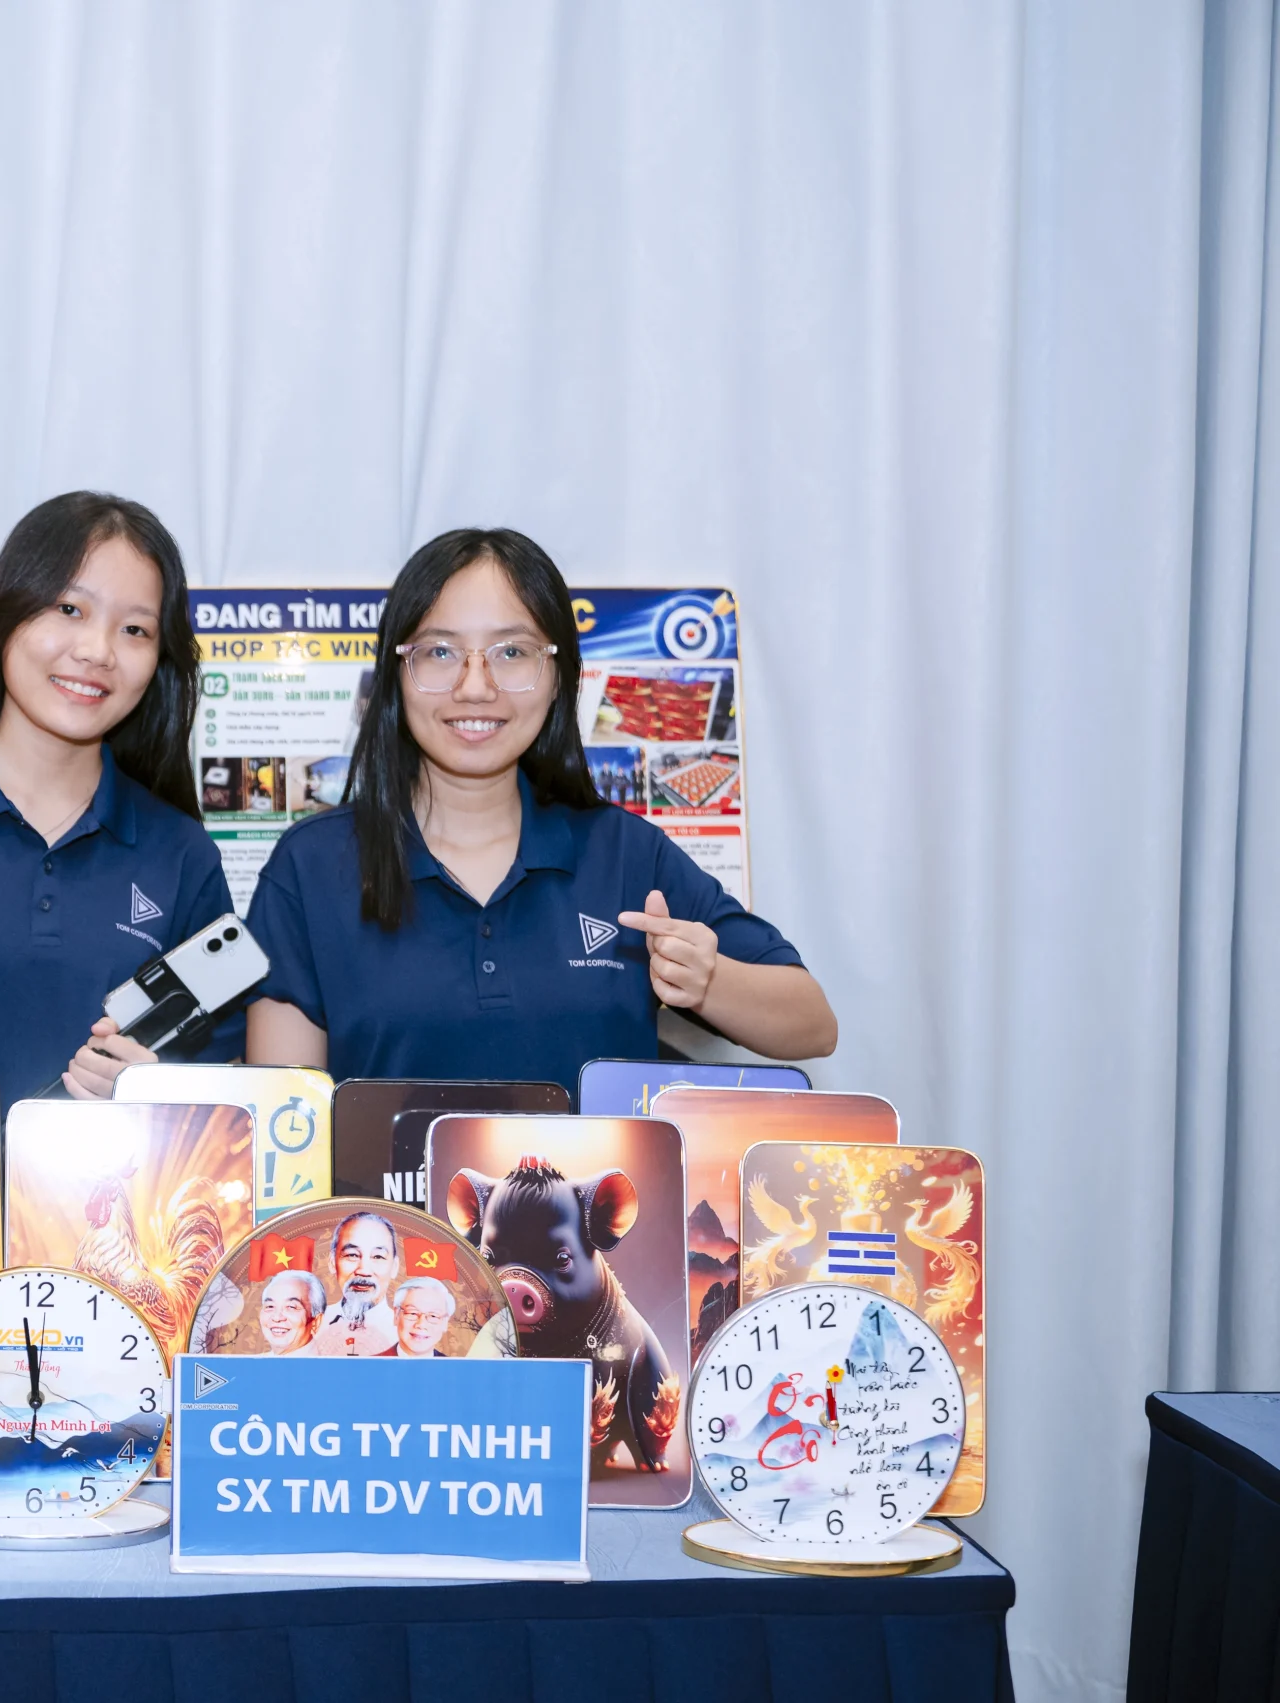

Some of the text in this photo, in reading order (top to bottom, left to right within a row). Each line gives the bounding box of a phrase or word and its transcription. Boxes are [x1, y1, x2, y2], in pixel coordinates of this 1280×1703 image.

[195, 602, 282, 629] ĐANG
[287, 597, 342, 629] TÌM
[211, 639, 264, 661] HỢP
[204, 678, 227, 695] 02
[115, 922, 130, 933] TOM
[19, 1281, 55, 1308] 12
[86, 1294, 97, 1320] 1
[800, 1302, 836, 1329] 12
[869, 1309, 881, 1336] 1
[120, 1334, 138, 1360] 2
[749, 1324, 779, 1351] 11
[908, 1346, 926, 1373] 2
[717, 1364, 753, 1391] 10
[139, 1387, 157, 1413] 3
[932, 1397, 950, 1424] 3
[51, 1419, 87, 1431] Minh
[90, 1420, 111, 1434] Lợi
[209, 1414, 551, 1459] CÔNG TY TNHH
[708, 1417, 726, 1443] 9
[117, 1438, 136, 1465] 4
[915, 1451, 934, 1477] 4
[78, 1476, 97, 1502] 5
[731, 1466, 748, 1492] 8
[25, 1488, 43, 1514] 6
[216, 1478, 543, 1517] SX TM DV TOM
[880, 1493, 897, 1519] 5
[773, 1498, 790, 1524] 7
[826, 1510, 844, 1536] 6
